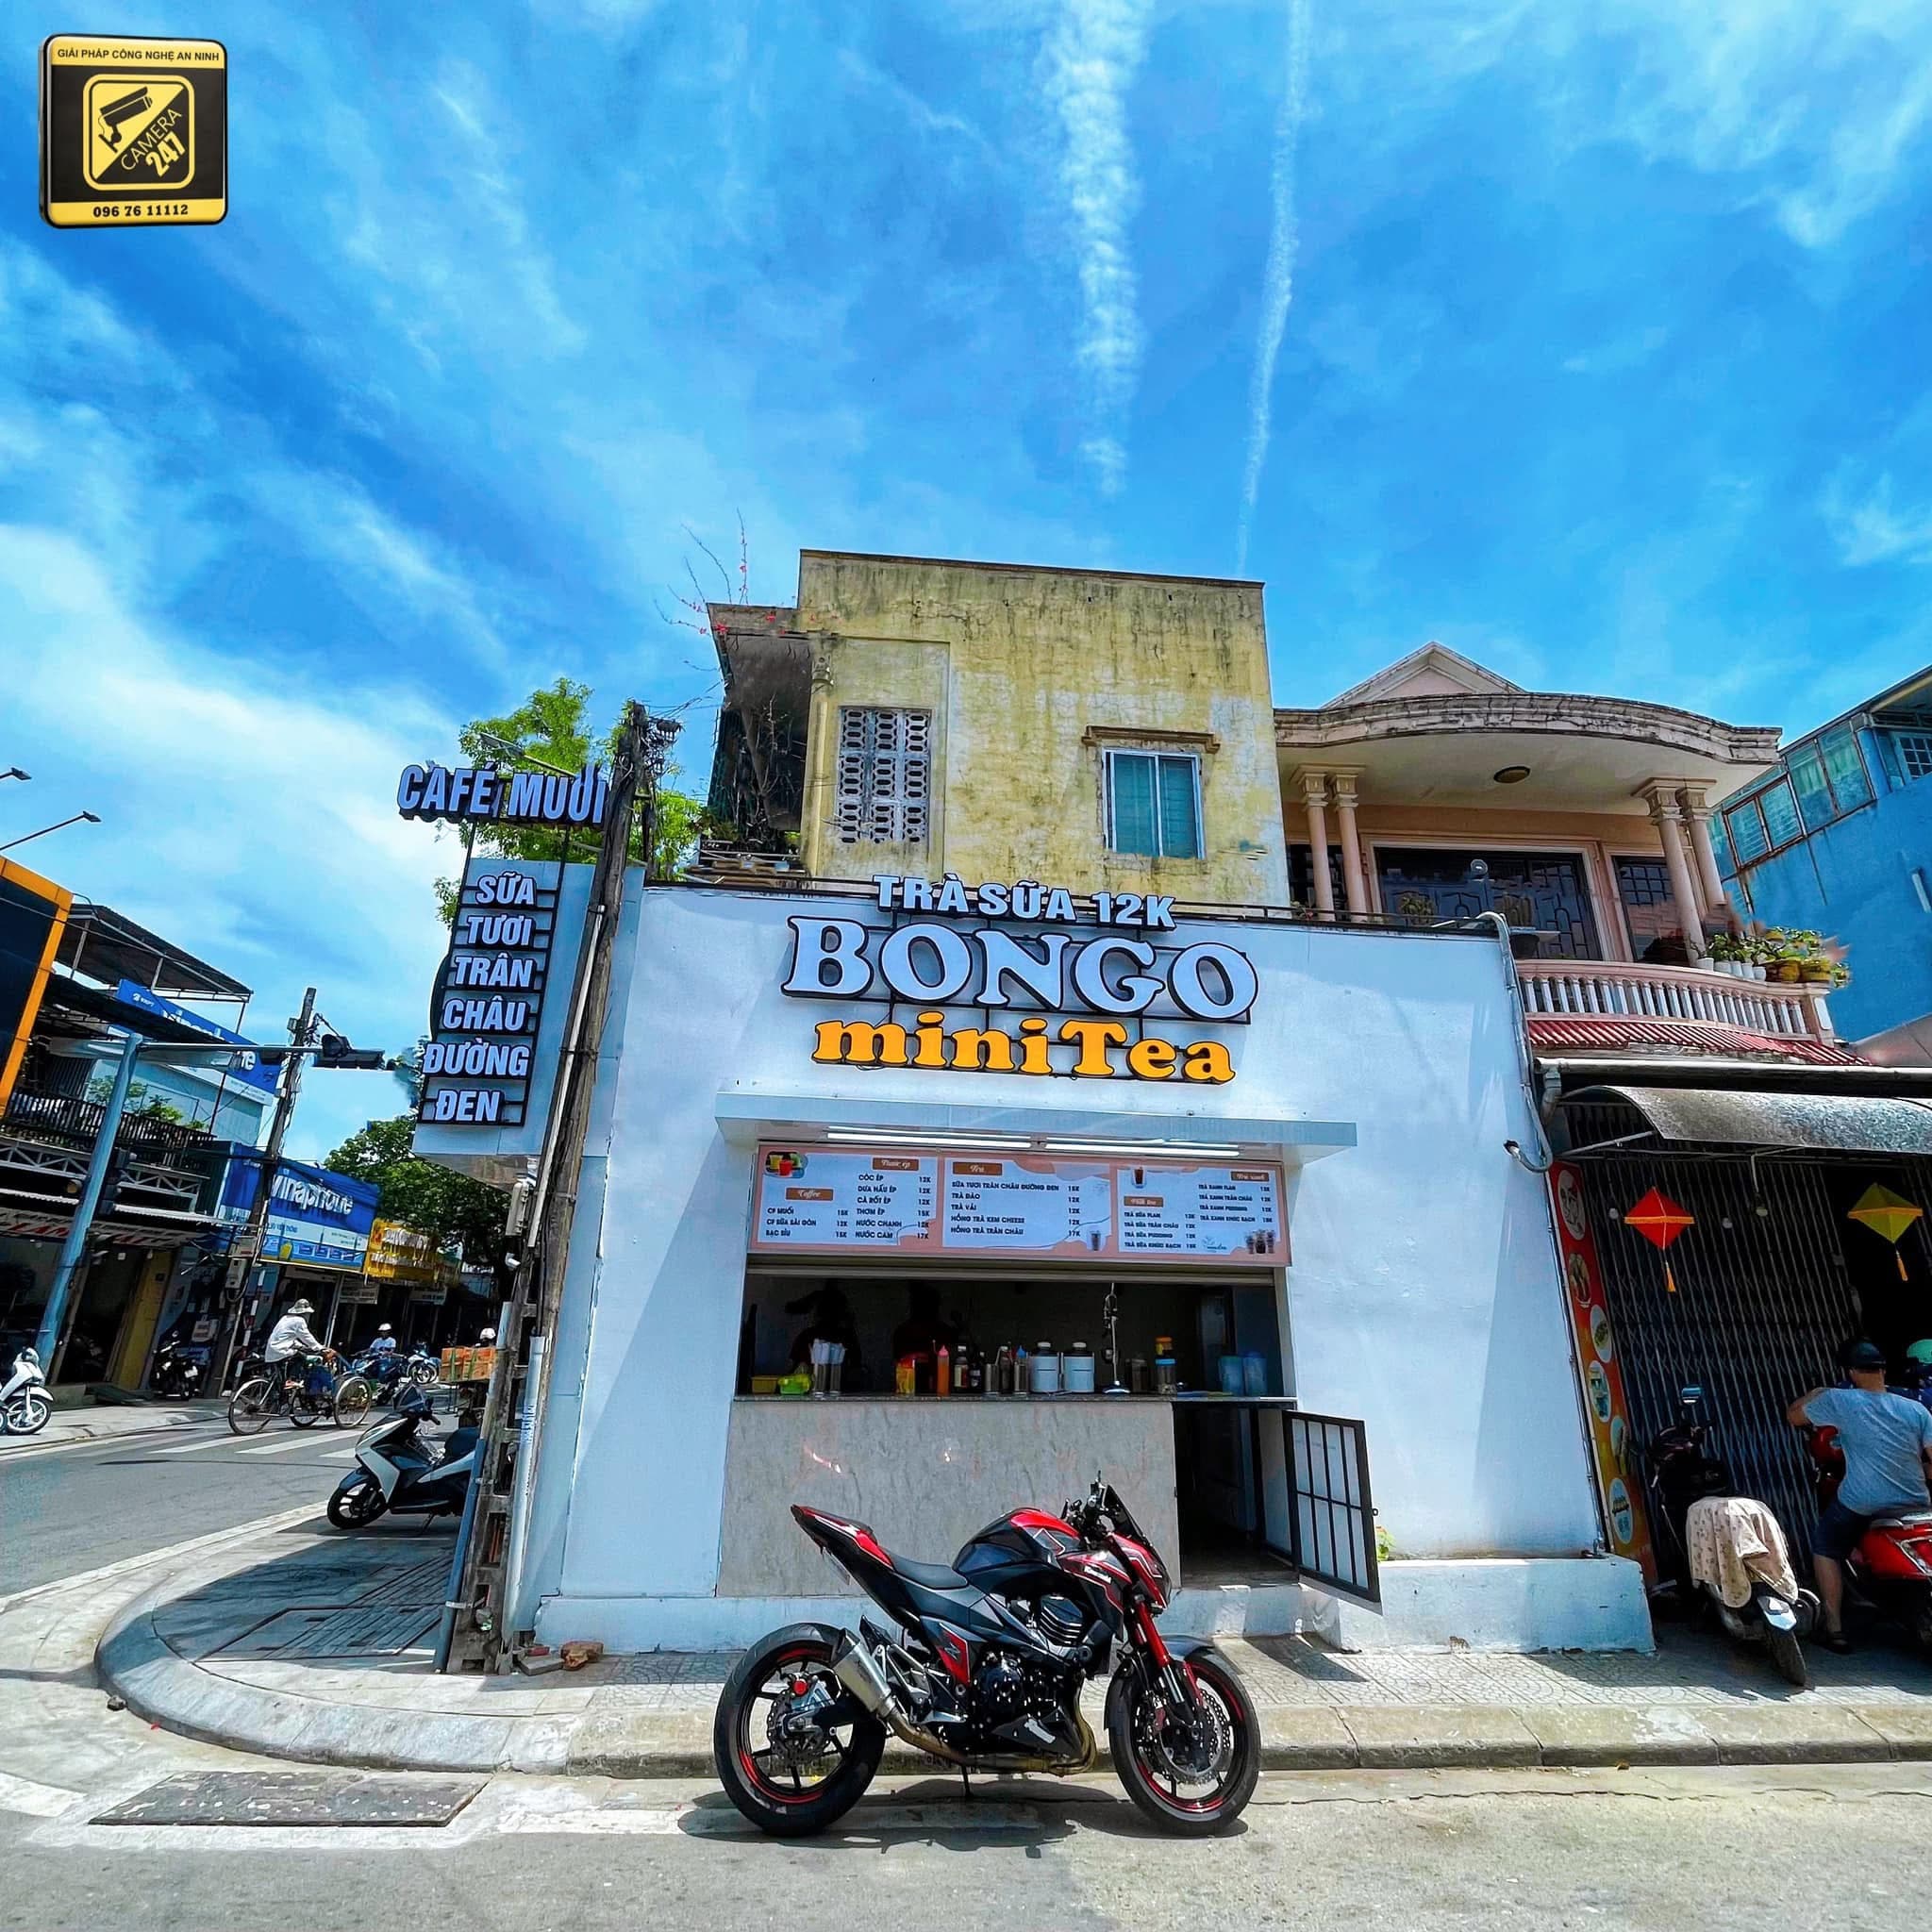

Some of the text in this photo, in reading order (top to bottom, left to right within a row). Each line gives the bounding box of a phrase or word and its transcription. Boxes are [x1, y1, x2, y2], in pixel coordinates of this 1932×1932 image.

[397, 761, 497, 816] CAFÉ
[475, 871, 536, 906] SỮA
[873, 874, 1177, 929] TRÀ SỮA 12K
[467, 914, 534, 947] TƯƠI
[454, 953, 534, 988] TRÂN
[781, 915, 1258, 1020] BONGO
[442, 995, 527, 1031] CHÂU
[423, 1038, 530, 1077] ĐƯỜNG
[434, 1090, 501, 1123] ĐEN
